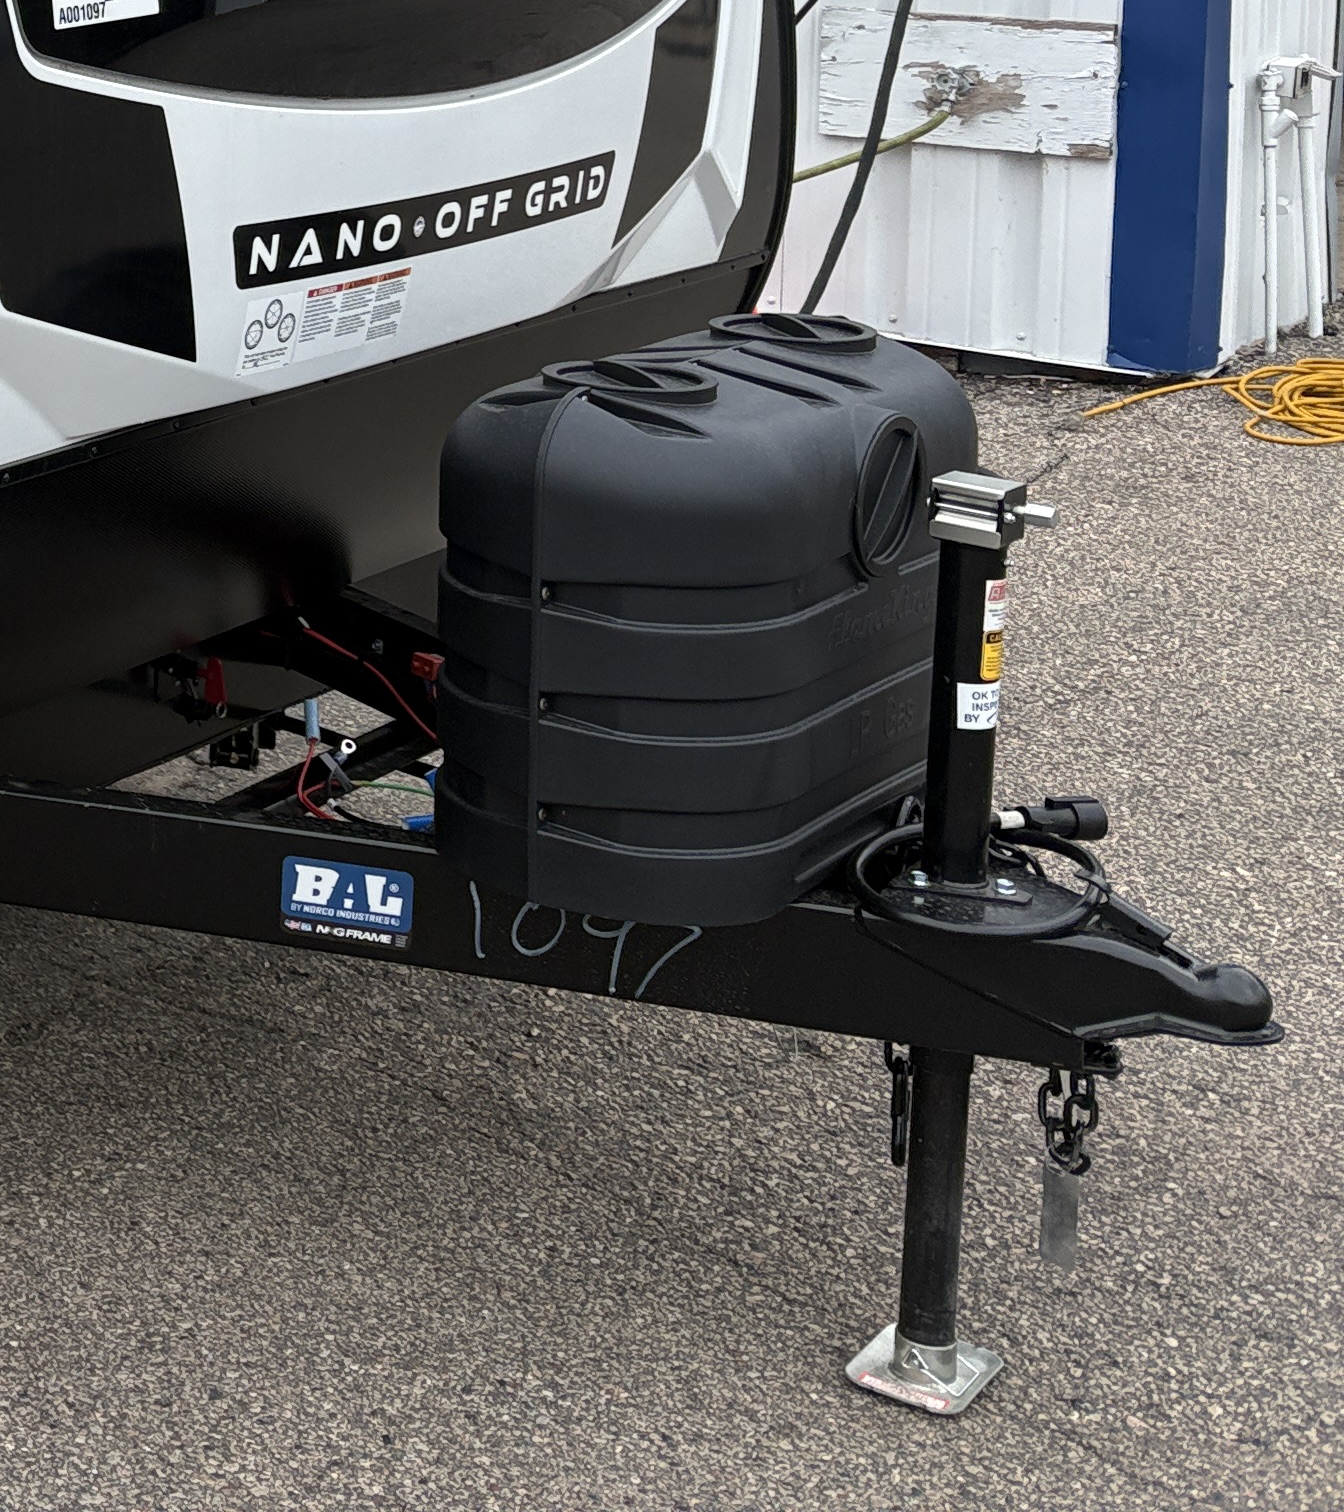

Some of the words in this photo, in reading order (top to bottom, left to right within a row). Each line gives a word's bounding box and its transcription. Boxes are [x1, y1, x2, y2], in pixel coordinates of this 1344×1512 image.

[58, 1, 106, 25] A001097
[248, 213, 402, 276] NANO
[434, 188, 512, 240] OFF
[525, 165, 606, 217] GRID
[971, 690, 989, 701] OK
[964, 713, 981, 723] BY
[291, 863, 404, 917] BAL
[302, 904, 335, 917] NORCO
[335, 909, 391, 926] INDUSTRIES
[345, 928, 393, 945] FRAME
[469, 880, 703, 999] 1097
